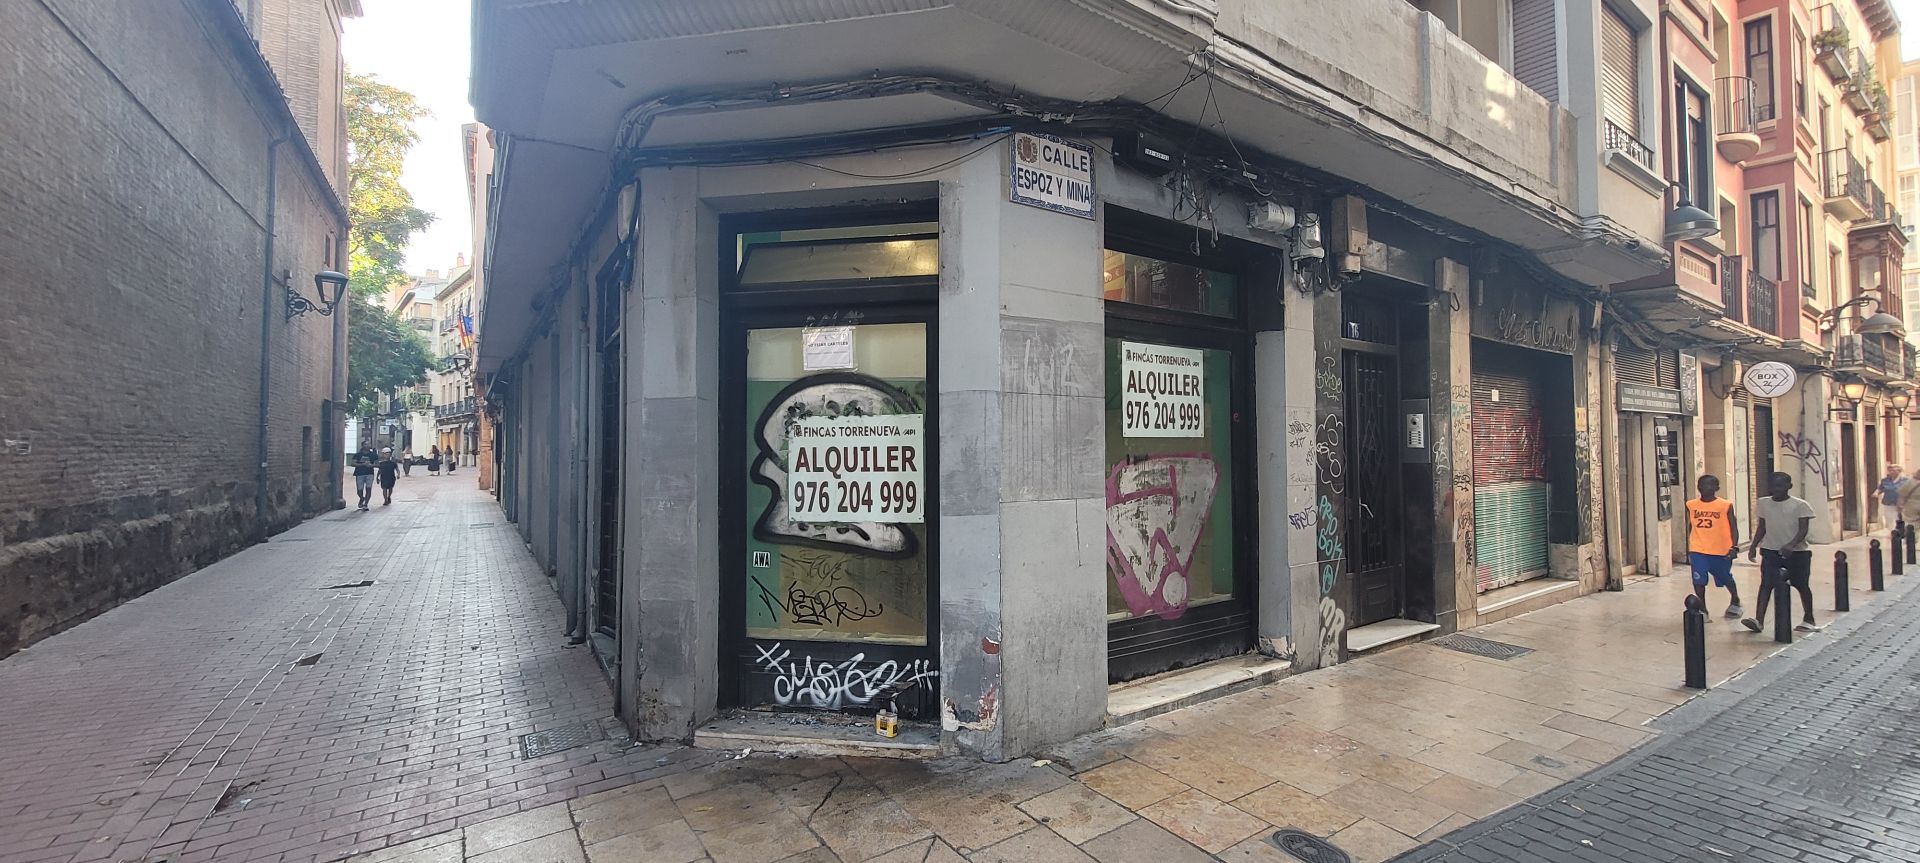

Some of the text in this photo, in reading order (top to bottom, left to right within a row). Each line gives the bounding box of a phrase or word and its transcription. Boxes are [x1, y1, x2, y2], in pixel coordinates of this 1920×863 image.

[1043, 145, 1088, 173] CALLE
[1017, 167, 1091, 205] ESPOZ Y MINA
[1132, 351, 1154, 364] FINCAS
[1155, 354, 1192, 367] TORRENUEVA
[1127, 369, 1201, 400] ALQUILER
[1126, 400, 1200, 430] 976 204 999
[803, 426, 836, 438] FINCAS
[838, 425, 901, 437] TORRENUEVA
[794, 445, 918, 480] ALQUILER
[794, 480, 917, 514] 976 204 999
[1696, 518, 1713, 529] 23
[754, 552, 771, 567] AWA
